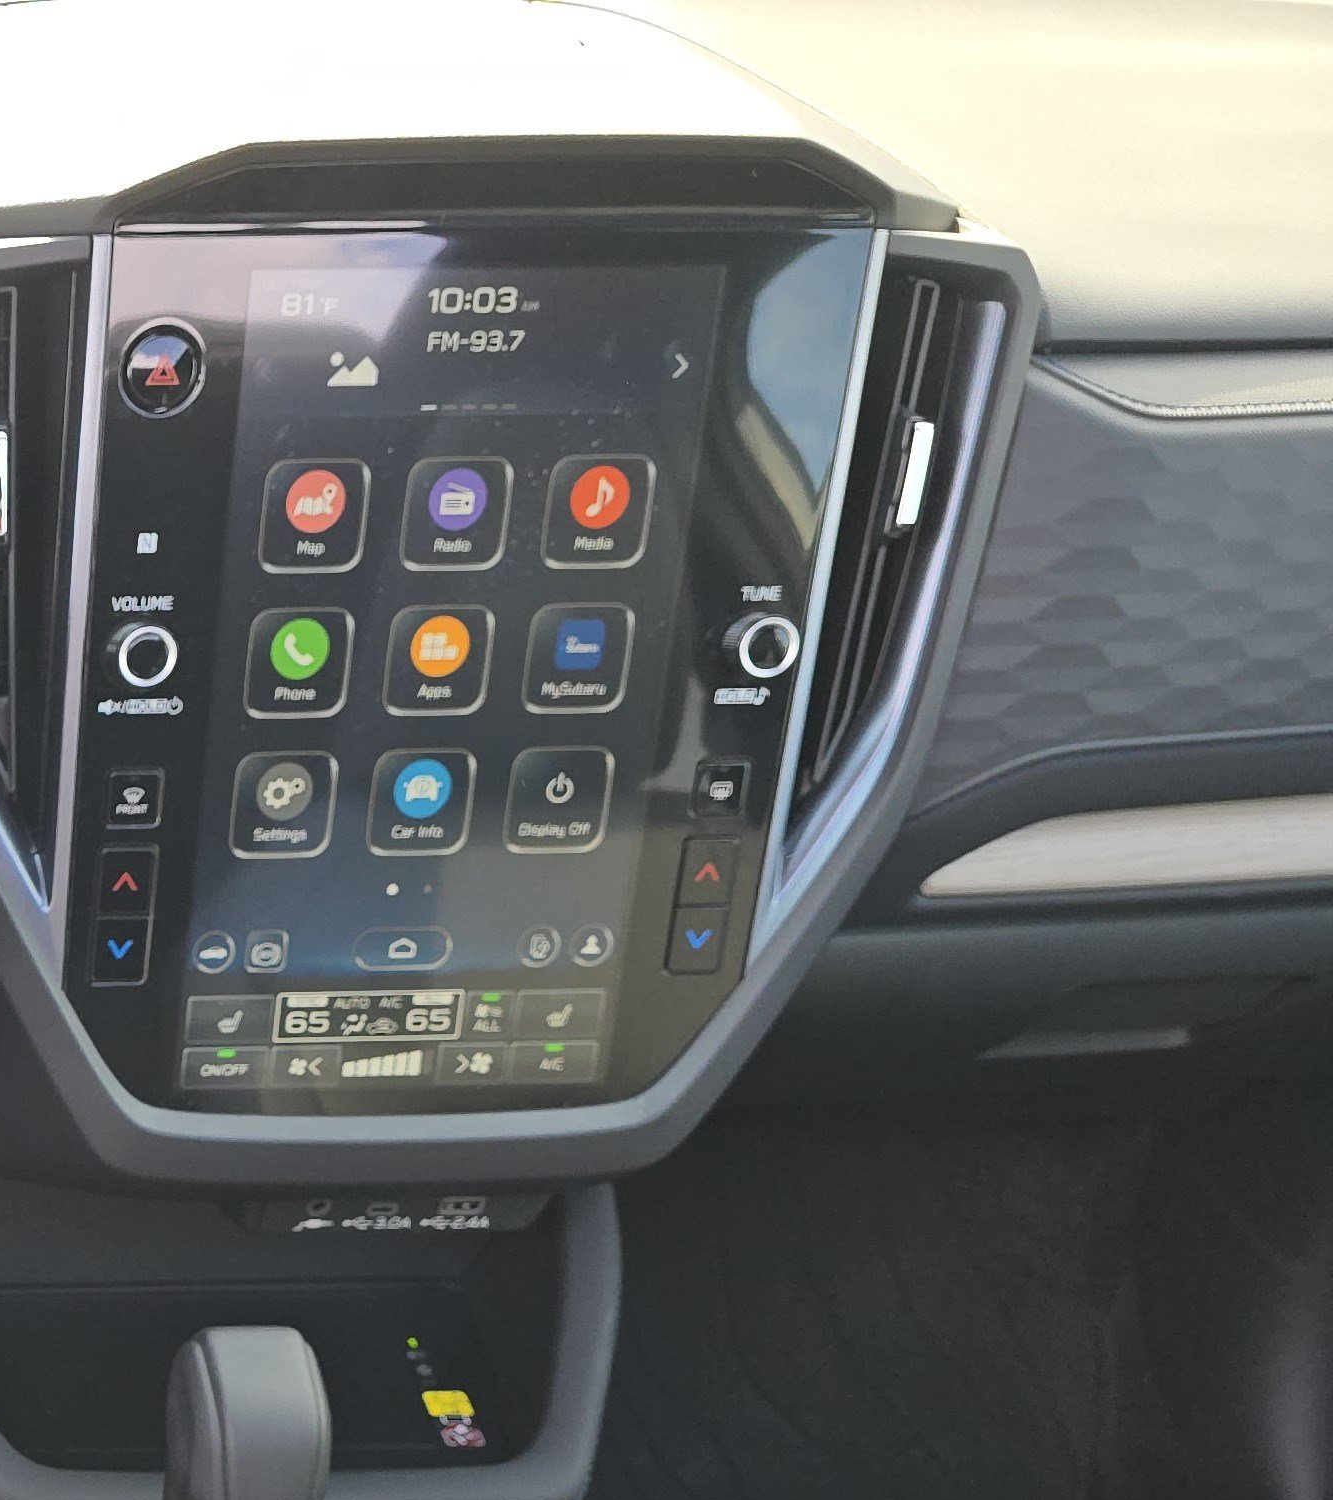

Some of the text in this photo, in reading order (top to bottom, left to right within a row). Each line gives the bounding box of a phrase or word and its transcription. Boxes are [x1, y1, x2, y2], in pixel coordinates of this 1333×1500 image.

[427, 286, 519, 315] 10:03
[426, 329, 527, 353] FM-93.7
[296, 539, 327, 558] Map
[432, 537, 473, 554] Radio
[573, 535, 615, 552] Media
[739, 584, 784, 602] TUNE
[111, 594, 175, 612] VOLUME
[274, 686, 317, 702] Phone
[416, 683, 454, 701] Apps
[252, 827, 308, 845] Settings
[390, 824, 445, 840] Car Info
[517, 821, 592, 839] Display Off
[283, 1010, 332, 1036] 65
[404, 1008, 452, 1034] 65
